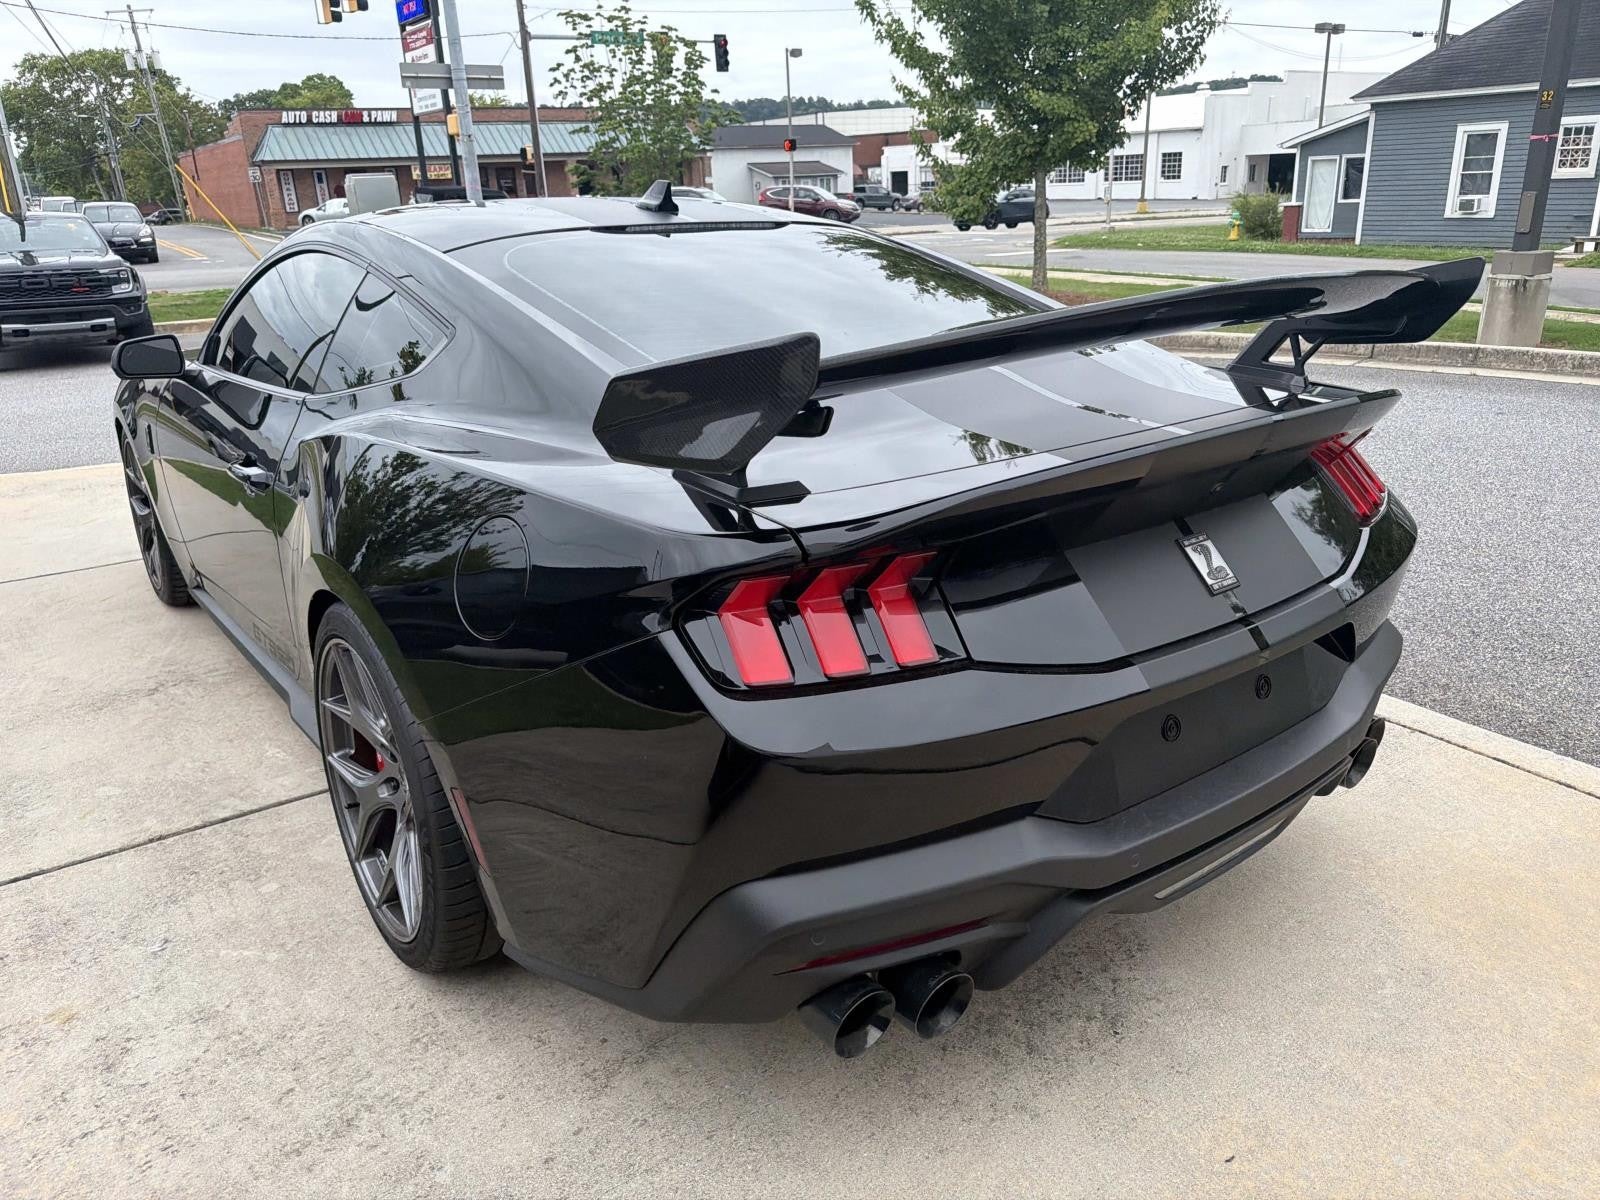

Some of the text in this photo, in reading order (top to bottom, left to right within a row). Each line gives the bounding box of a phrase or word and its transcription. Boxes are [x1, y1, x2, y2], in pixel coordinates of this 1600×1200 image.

[1541, 90, 1554, 101] 32
[282, 111, 307, 123] AUTO
[312, 110, 337, 123] CASH
[362, 110, 370, 122] &
[371, 110, 397, 122] PAWN
